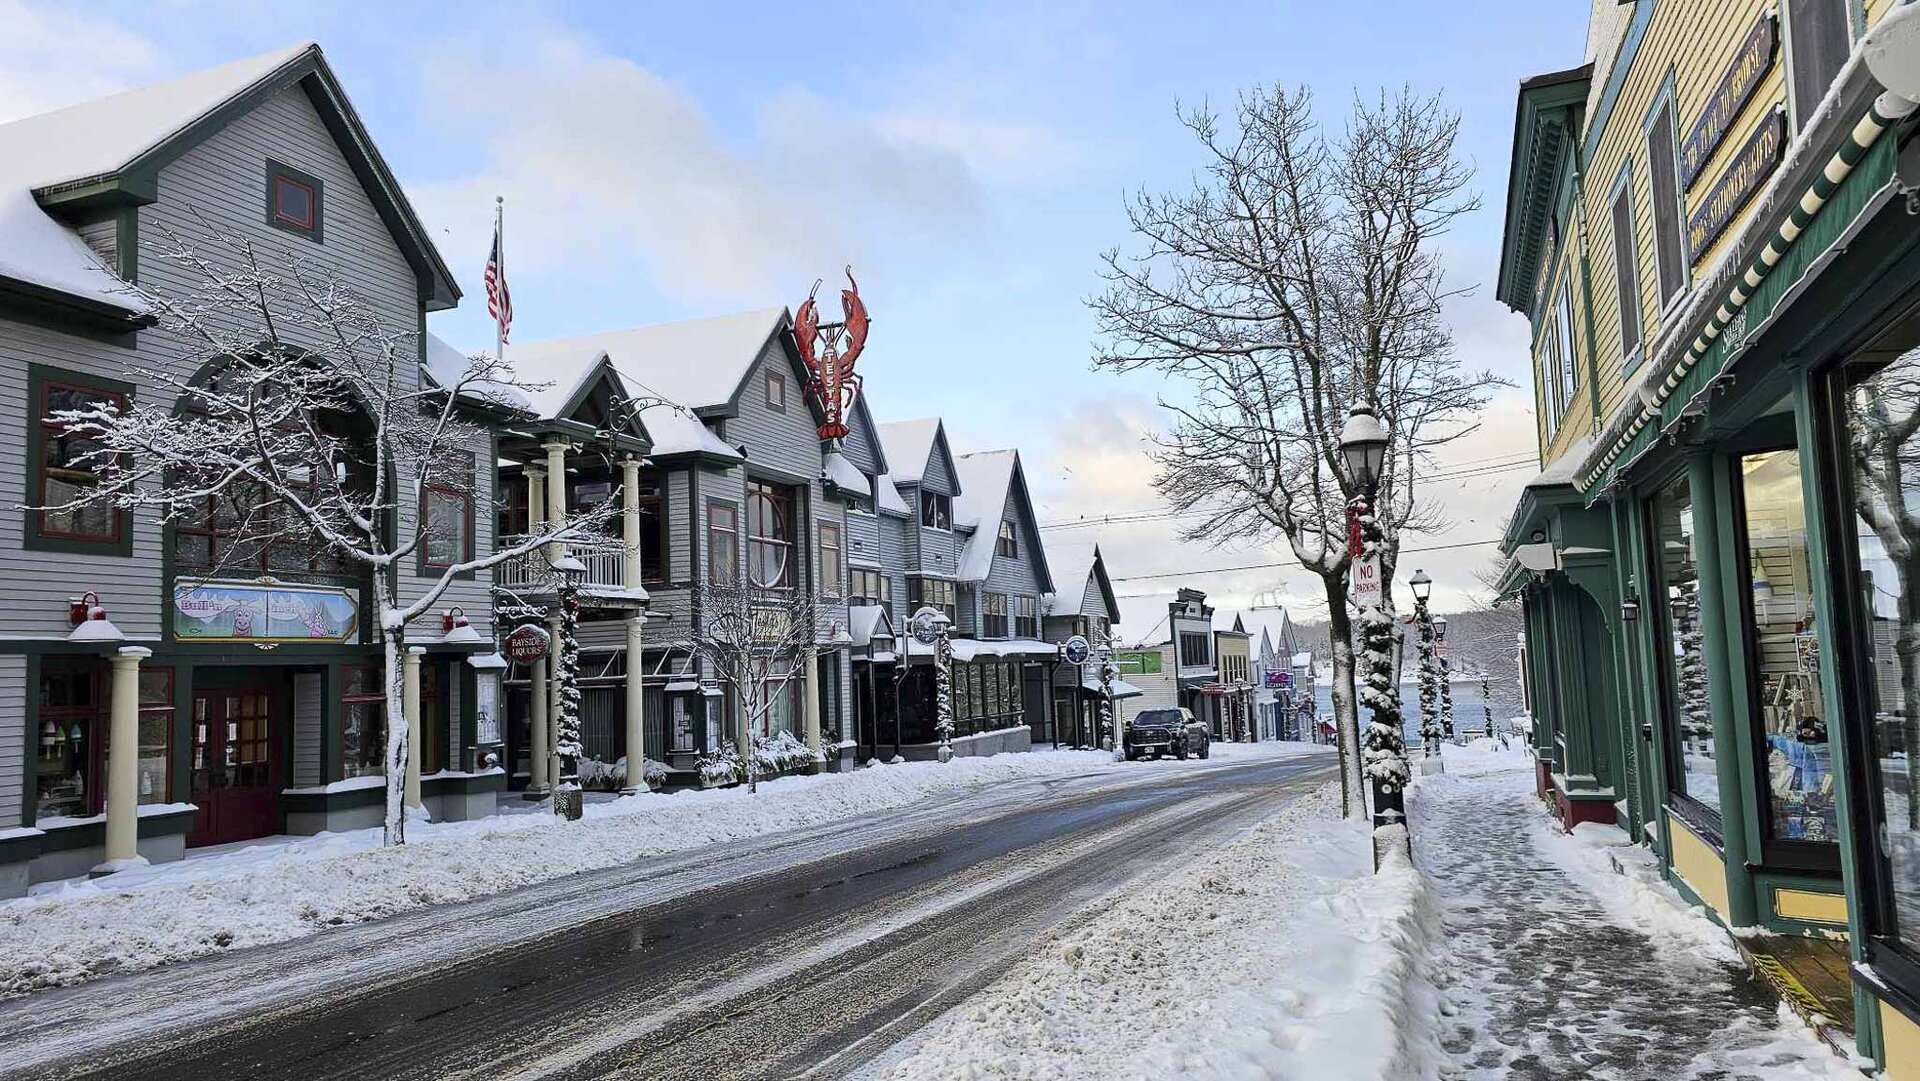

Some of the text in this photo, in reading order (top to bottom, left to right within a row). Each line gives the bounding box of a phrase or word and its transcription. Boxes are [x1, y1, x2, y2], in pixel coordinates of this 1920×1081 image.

[1720, 88, 1730, 120] TO
[1751, 125, 1774, 174] GIFTS
[1360, 564, 1373, 580] NO
[1356, 581, 1379, 593] PARKING
